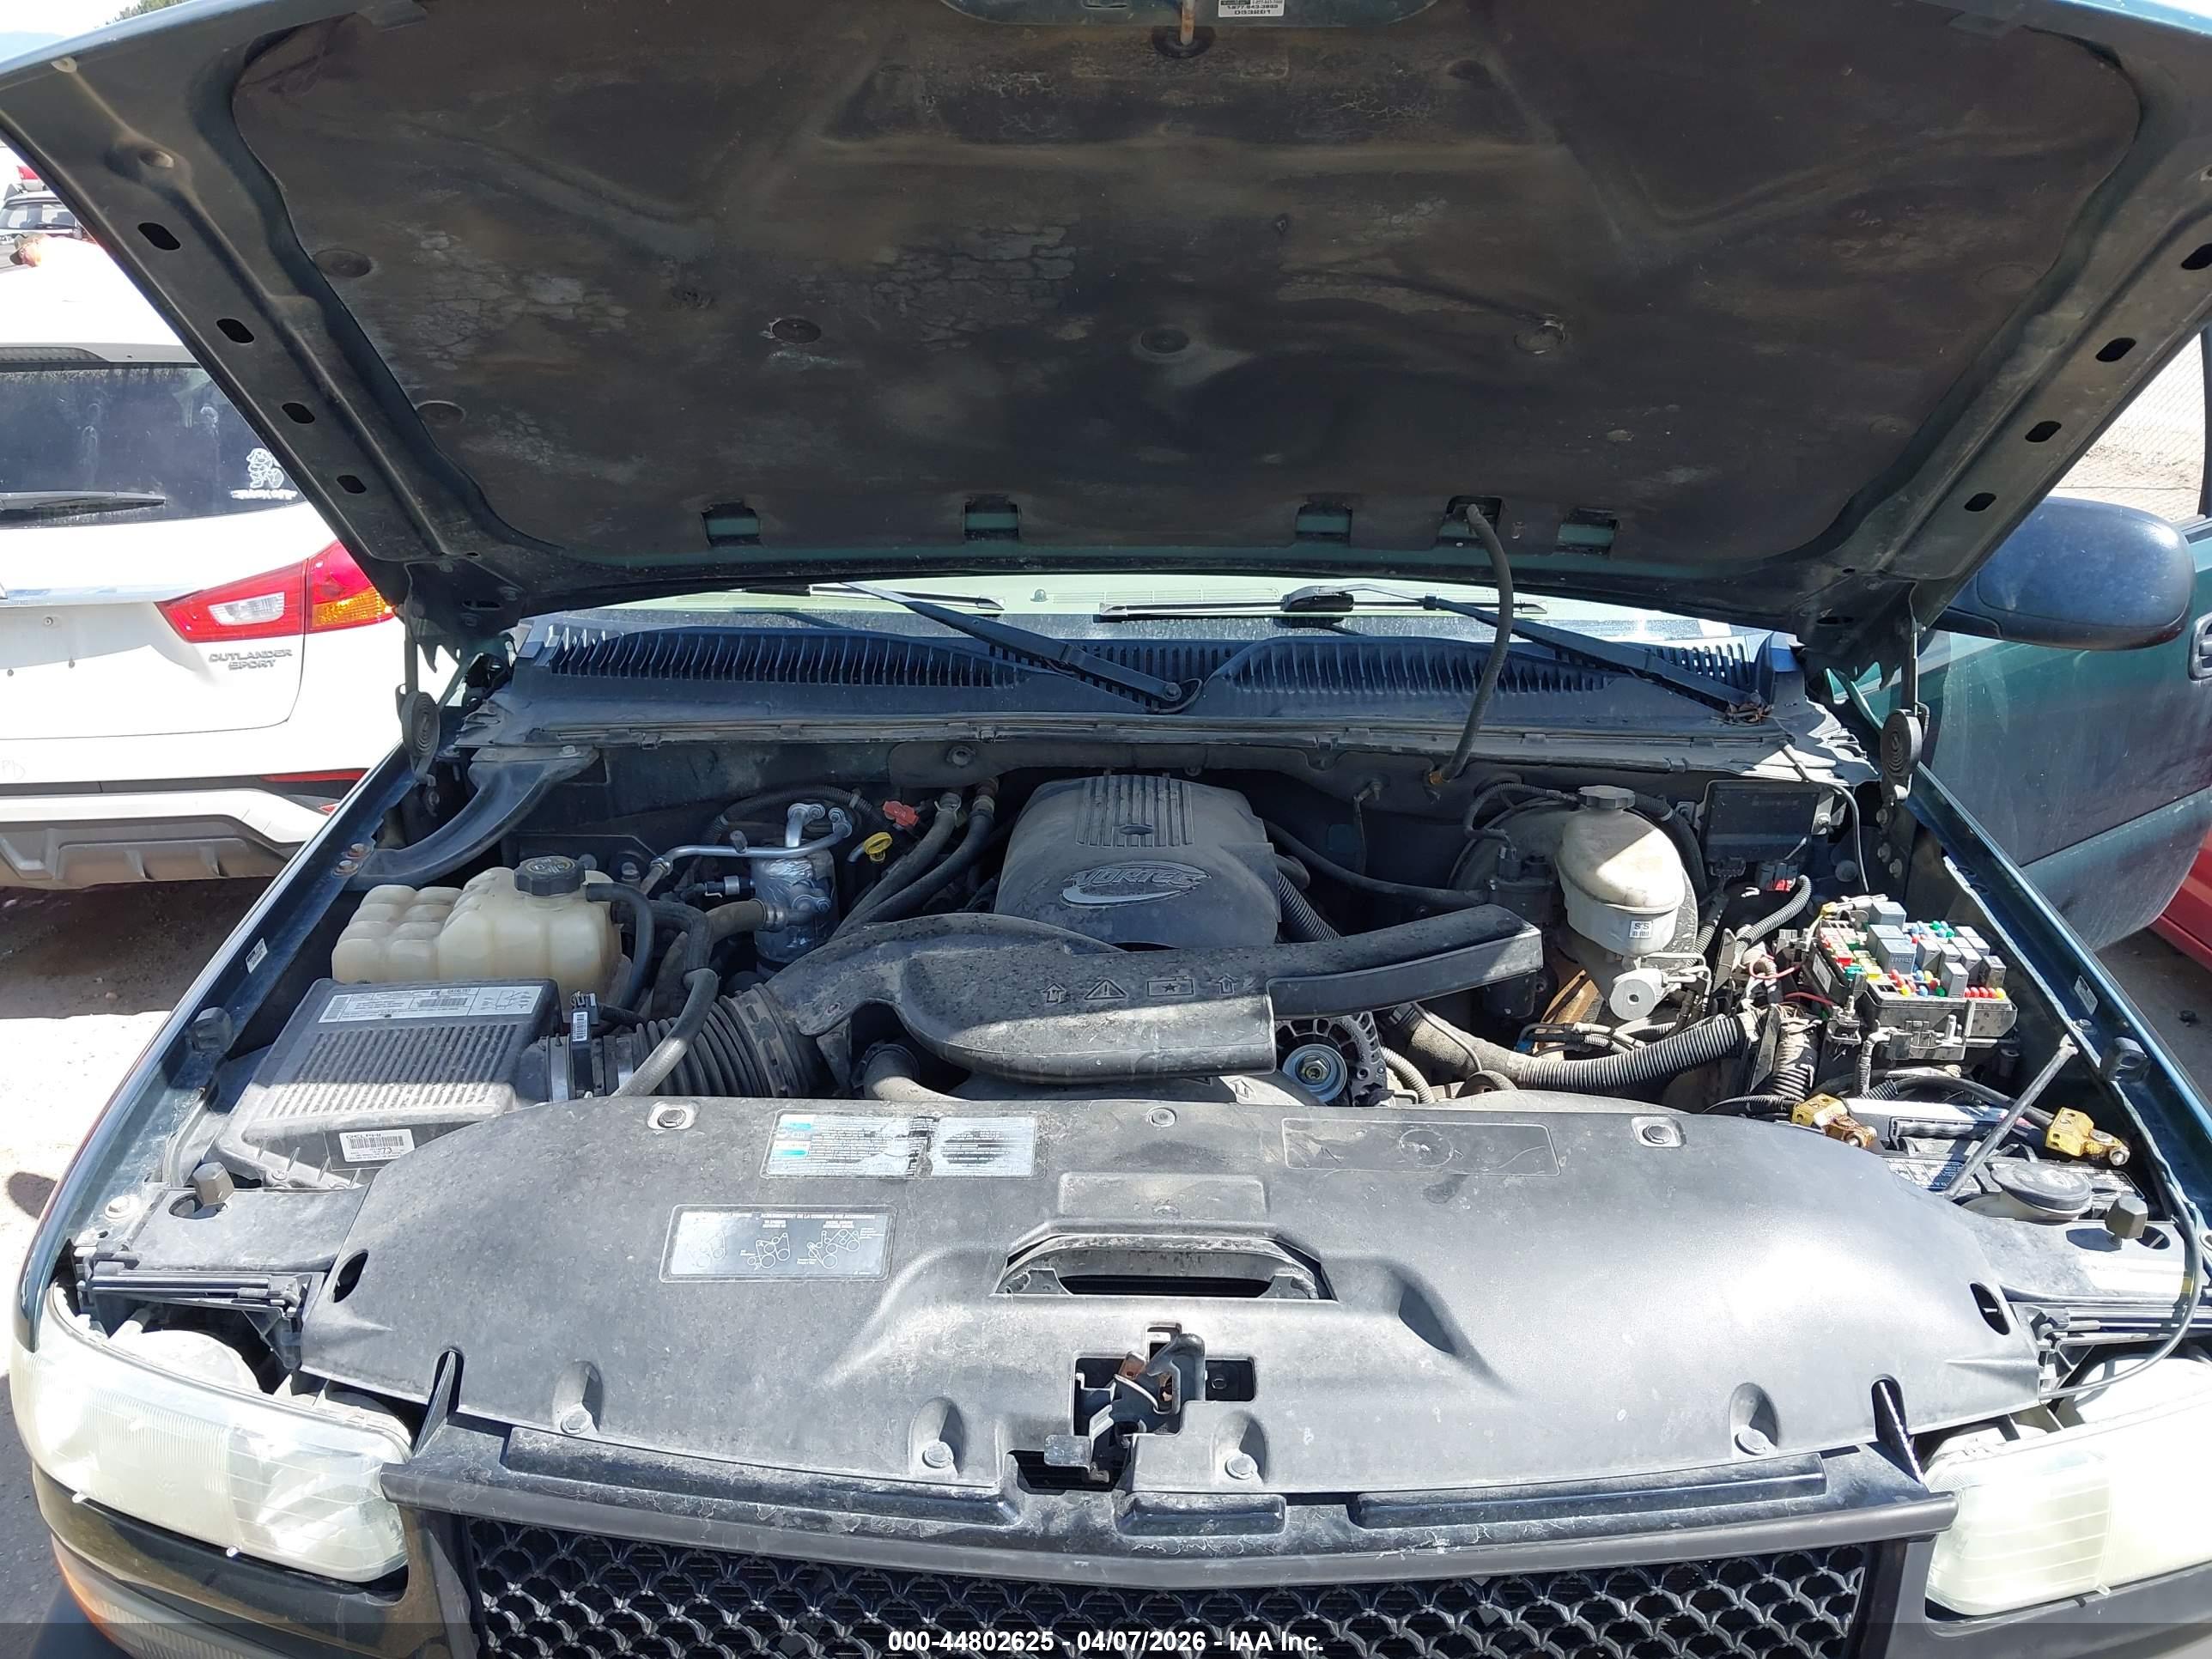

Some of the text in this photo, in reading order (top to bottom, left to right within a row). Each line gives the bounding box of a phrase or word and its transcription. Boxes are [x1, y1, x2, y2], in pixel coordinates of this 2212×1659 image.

[209, 649, 293, 663] OUTLANDER
[228, 659, 276, 671] SPORT
[1063, 866, 1205, 890] VORTEC
